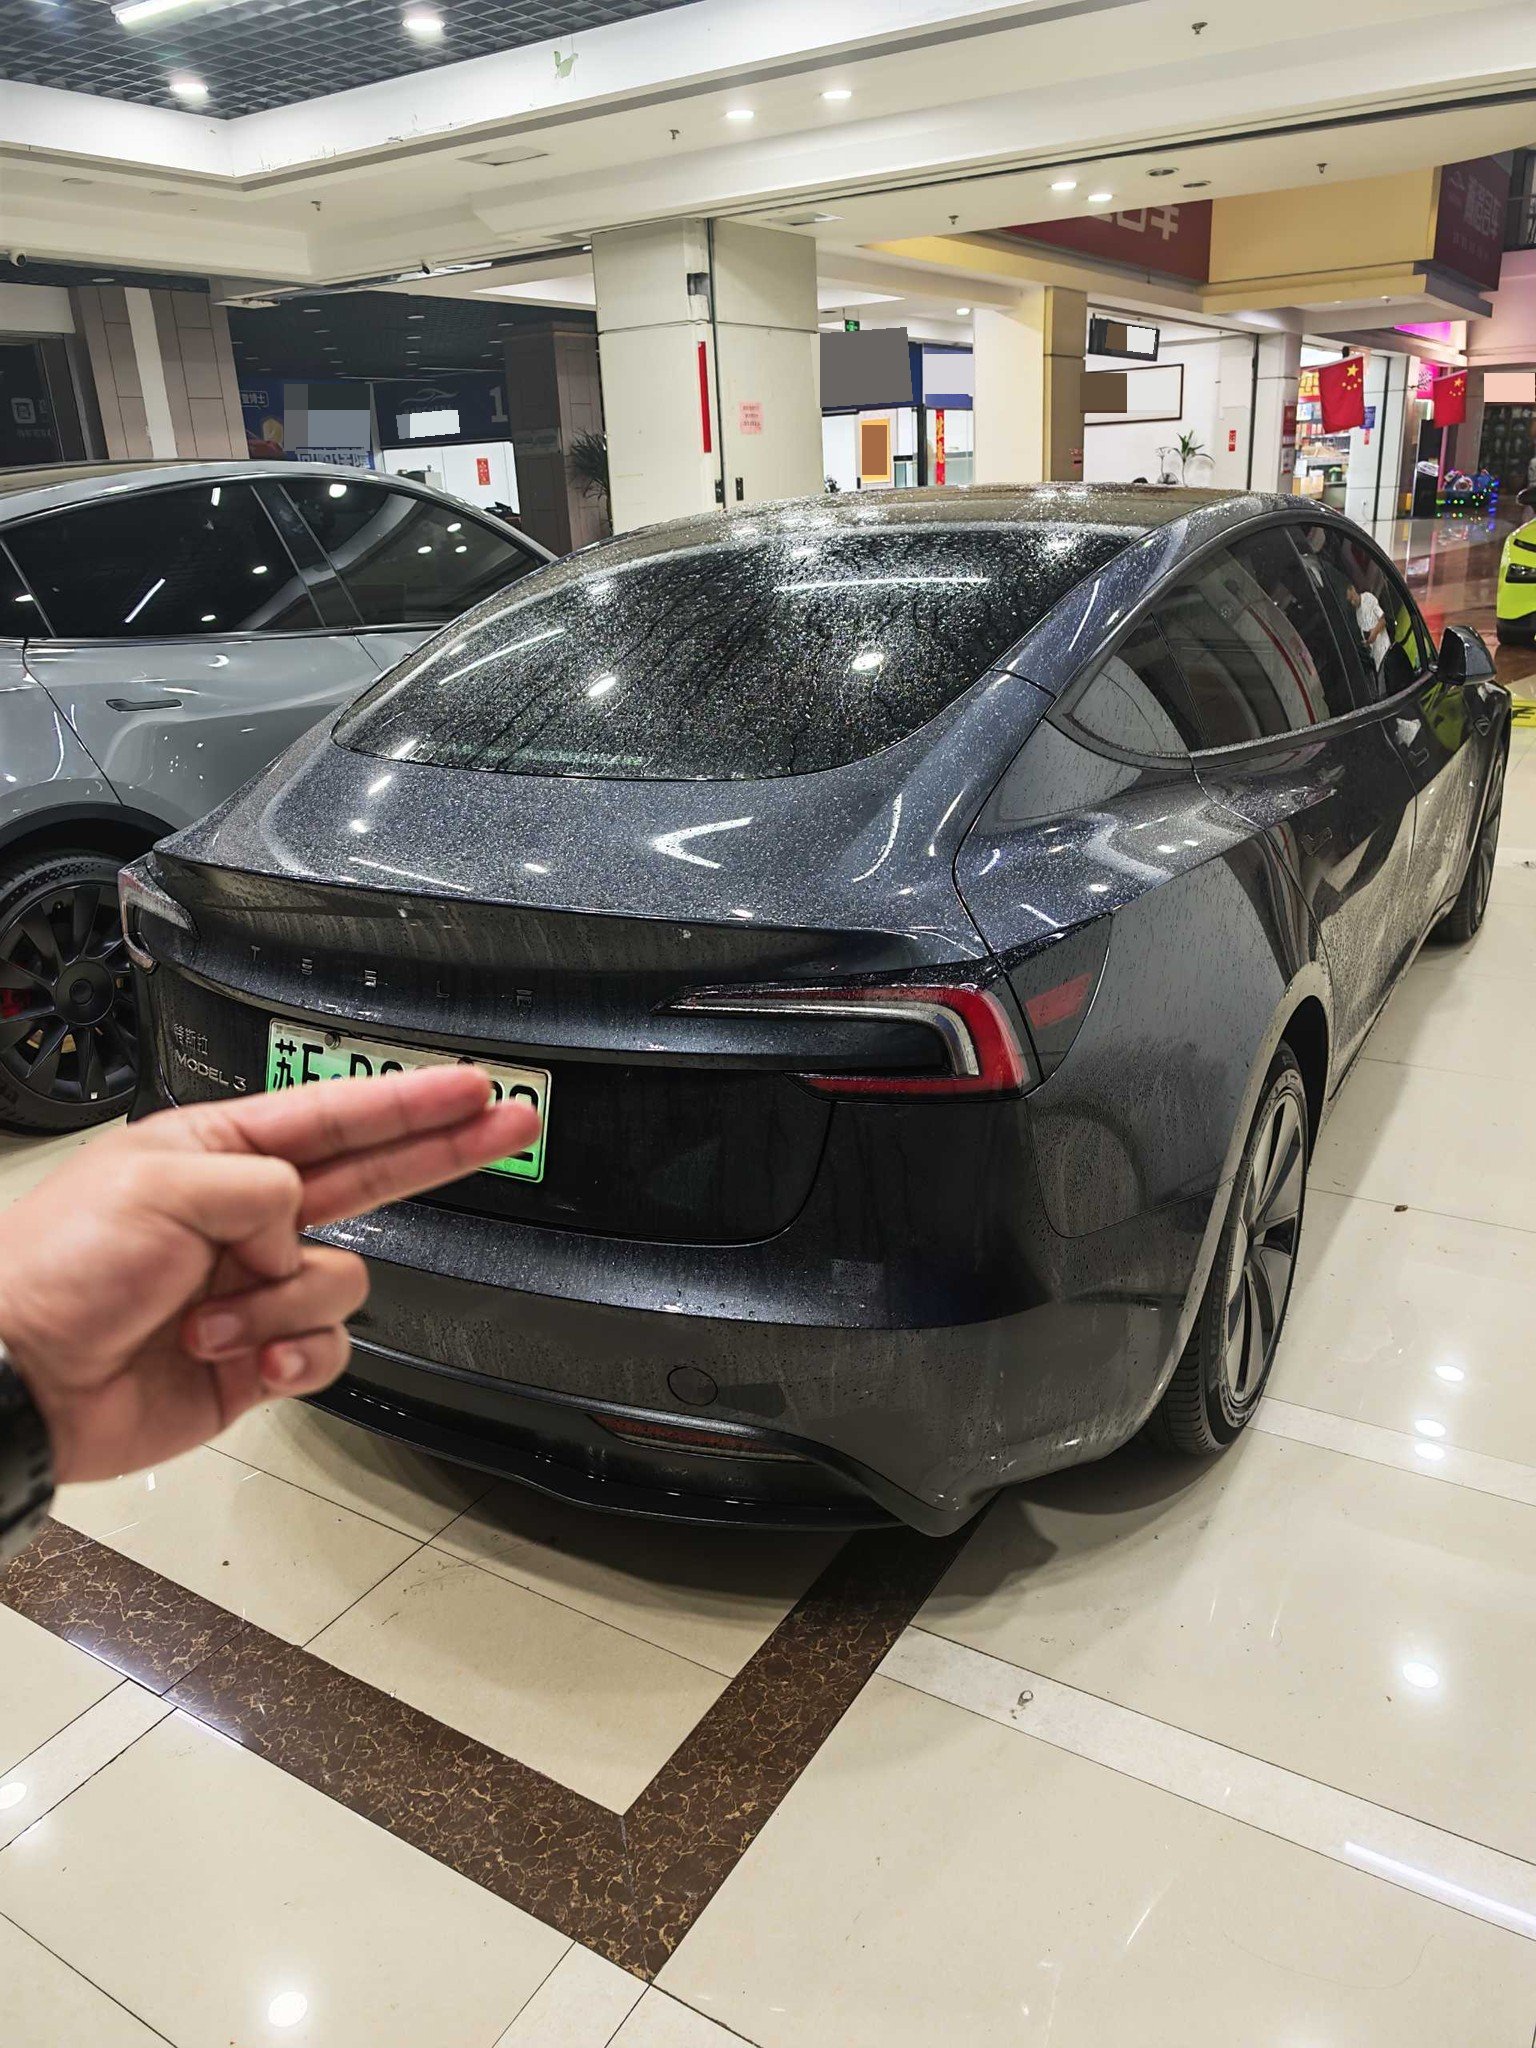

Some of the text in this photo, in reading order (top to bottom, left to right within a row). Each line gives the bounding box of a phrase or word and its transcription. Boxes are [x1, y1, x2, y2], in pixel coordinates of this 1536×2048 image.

[250, 946, 534, 1006] TESLA
[173, 1022, 209, 1055] 特斯拉
[174, 1049, 248, 1091] MODEL 3
